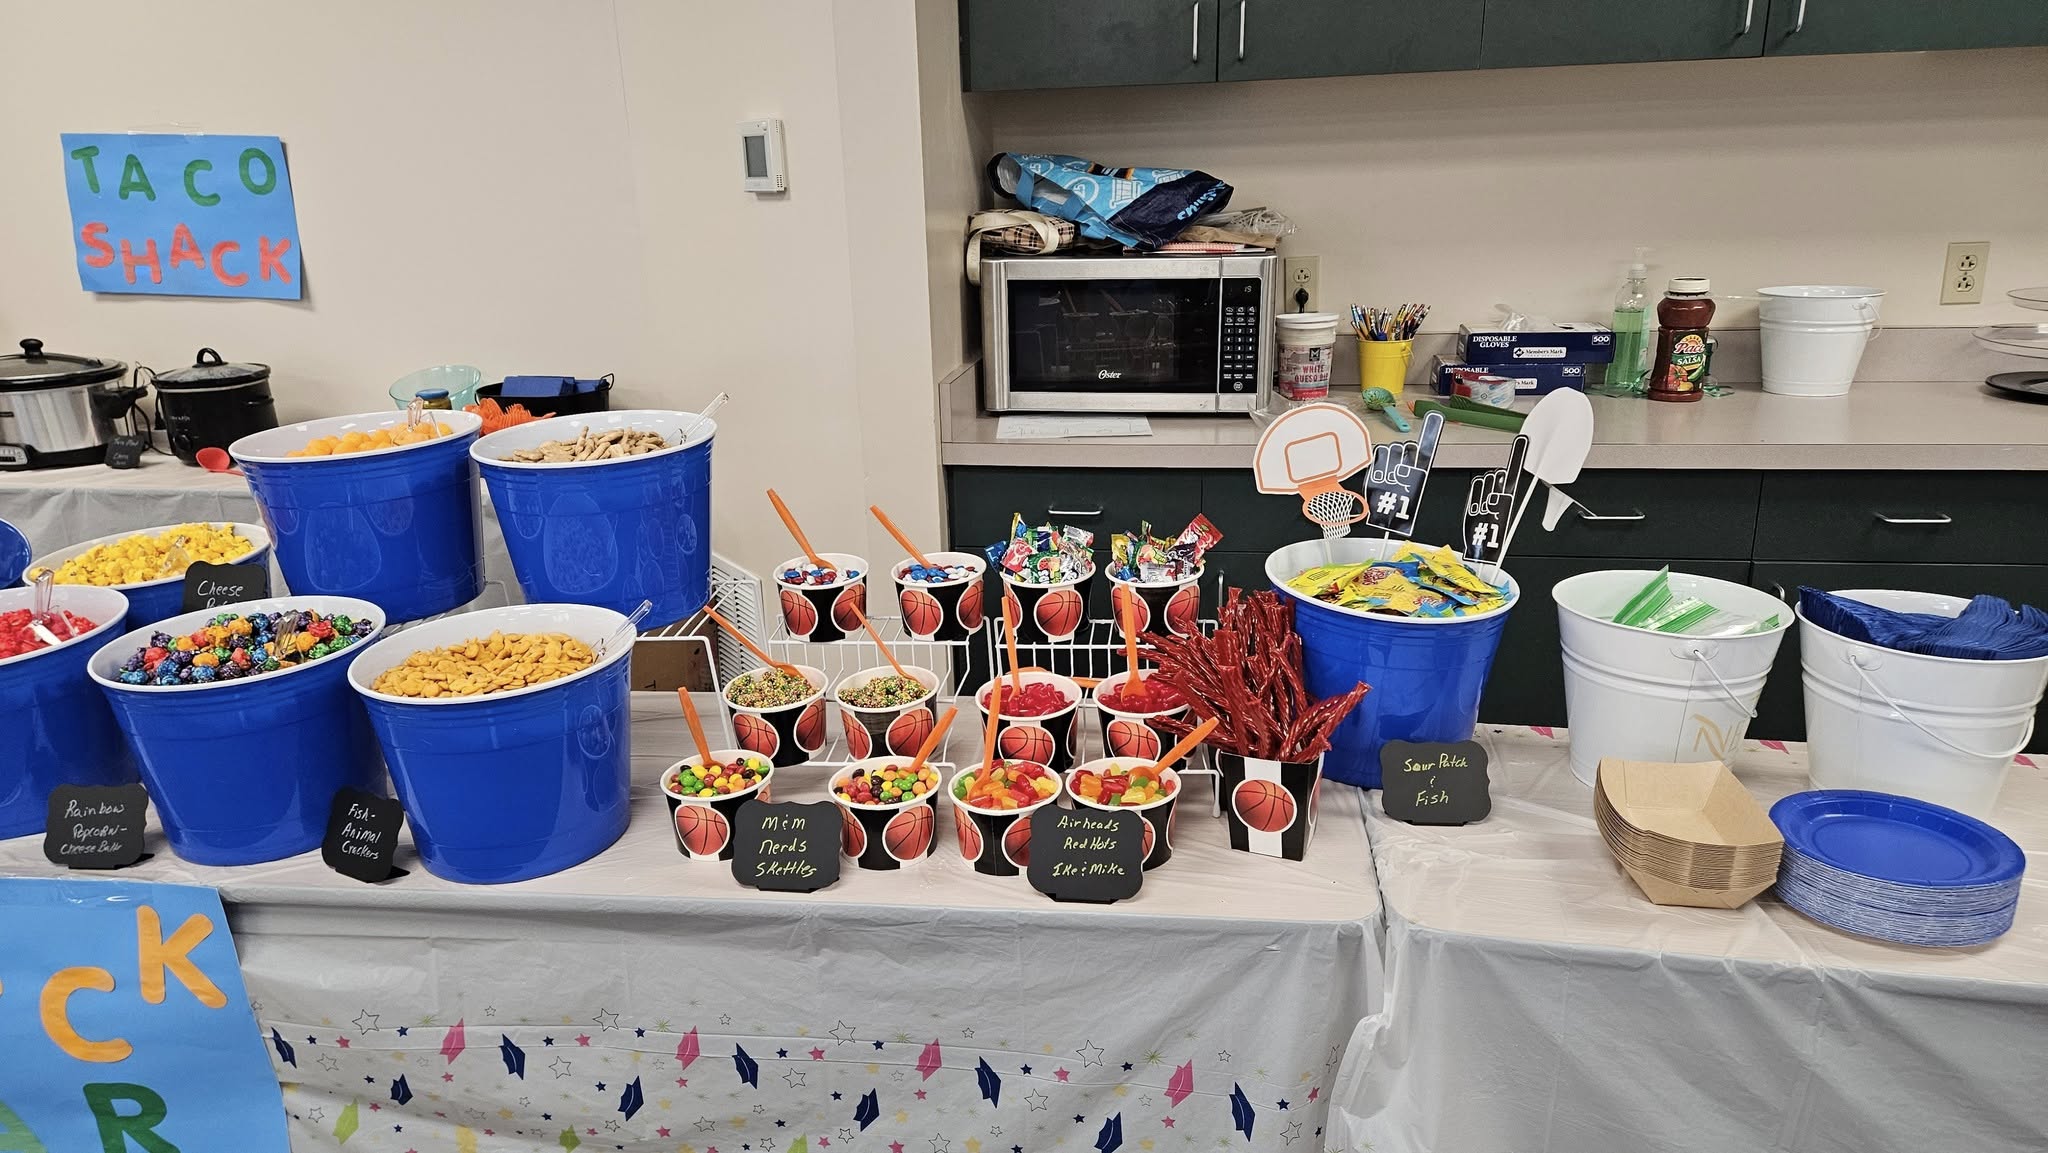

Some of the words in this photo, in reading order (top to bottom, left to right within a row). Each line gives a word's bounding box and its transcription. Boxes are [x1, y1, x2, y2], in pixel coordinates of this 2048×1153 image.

[71, 146, 277, 207] TACO
[81, 222, 292, 287] SHACK
[1472, 335, 1517, 343] DISPOSABLE
[1593, 335, 1610, 343] 500
[1677, 355, 1702, 365] SALSA
[1098, 369, 1121, 380] Oster
[1302, 364, 1325, 374] WHITE
[1294, 374, 1318, 383] QUESO
[1376, 491, 1410, 520] #1
[1471, 522, 1499, 549] #1
[197, 580, 244, 597] Cheese
[1403, 758, 1436, 772] Sour
[1438, 752, 1469, 769] Patch
[1415, 790, 1449, 807] Fish
[64, 799, 125, 819] Rainbow
[0, 905, 228, 1064] CK
